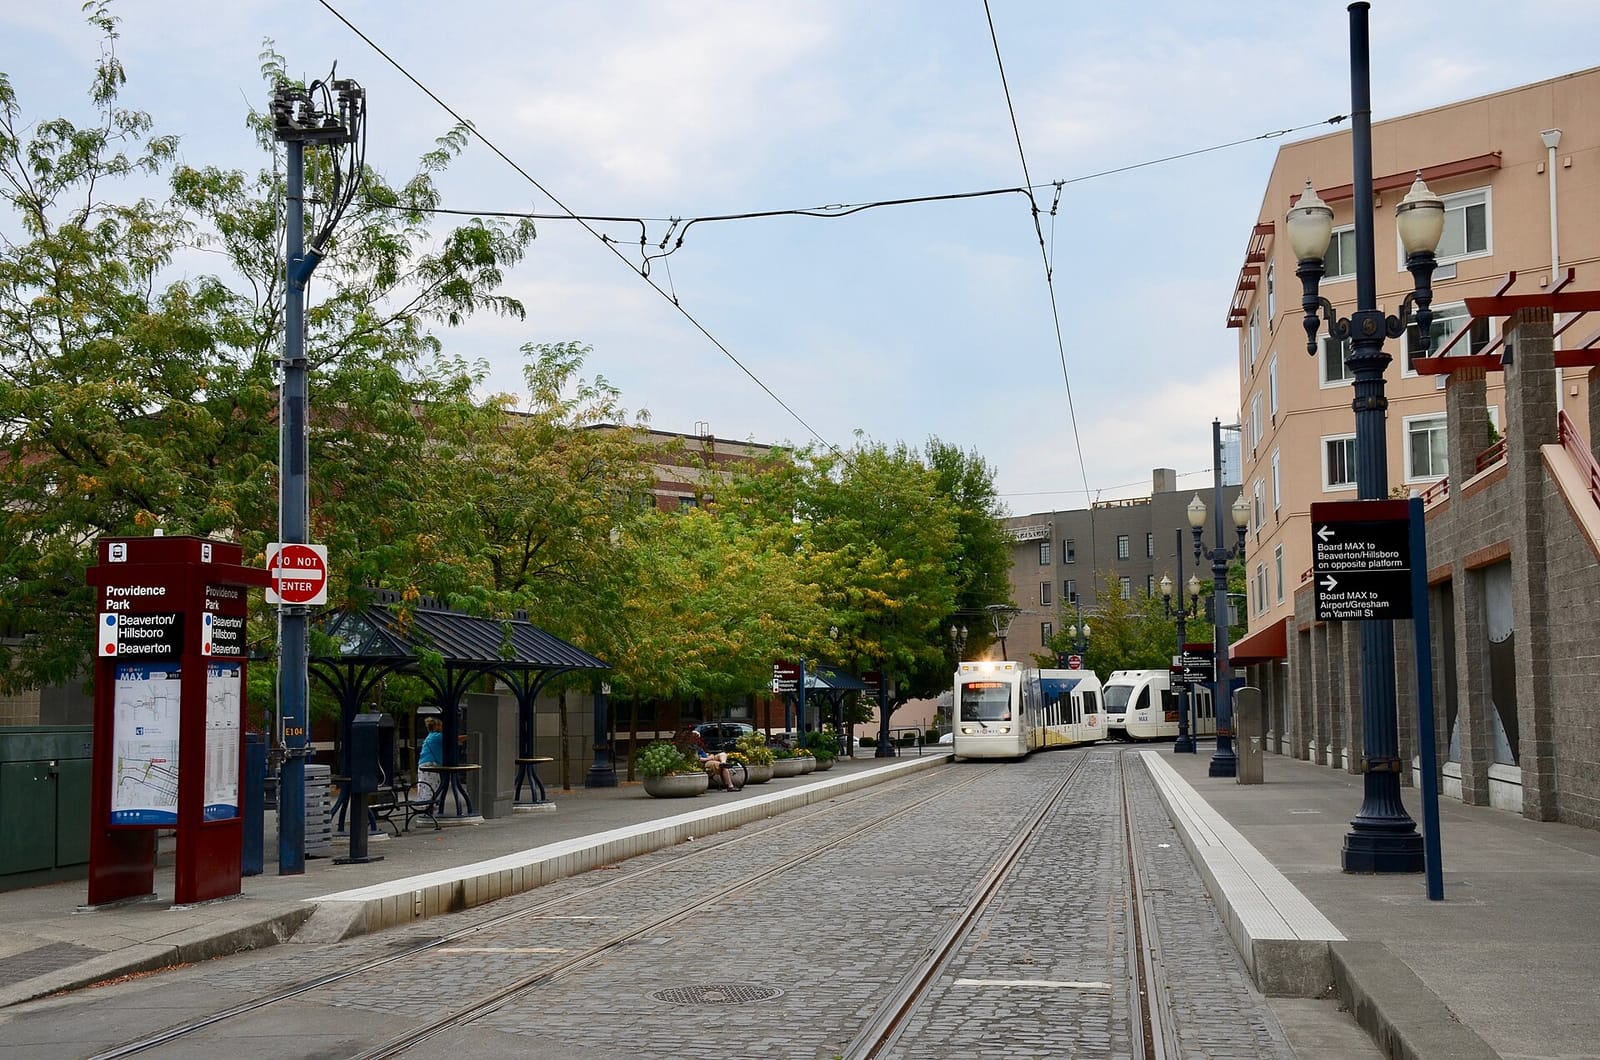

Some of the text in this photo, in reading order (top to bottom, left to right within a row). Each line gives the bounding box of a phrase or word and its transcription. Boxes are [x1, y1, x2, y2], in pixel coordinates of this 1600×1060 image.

[1317, 542, 1376, 551] Board MAX to
[1317, 550, 1399, 560] Beaverton/Hillsboro
[297, 556, 317, 567] NOT
[1331, 560, 1367, 570] opposite
[1368, 559, 1403, 569] platform
[106, 585, 166, 597] Providence
[205, 585, 238, 599] Providence
[281, 581, 313, 592] ENTER
[1319, 591, 1378, 600] Board MAX to
[105, 598, 130, 610] Park
[205, 598, 219, 610] Park
[1320, 600, 1390, 610] Airport/Gresham
[1332, 609, 1362, 618] Yamhill
[1364, 609, 1374, 617] St
[119, 613, 176, 626] Beaverton/
[212, 615, 243, 628] Beaverton/
[118, 627, 164, 638] Hillsboro
[212, 628, 237, 640] Hillsboro
[118, 642, 171, 654] Beaverton
[211, 642, 240, 655] Beaverton
[120, 672, 143, 681] MAX
[285, 727, 303, 736] E104
